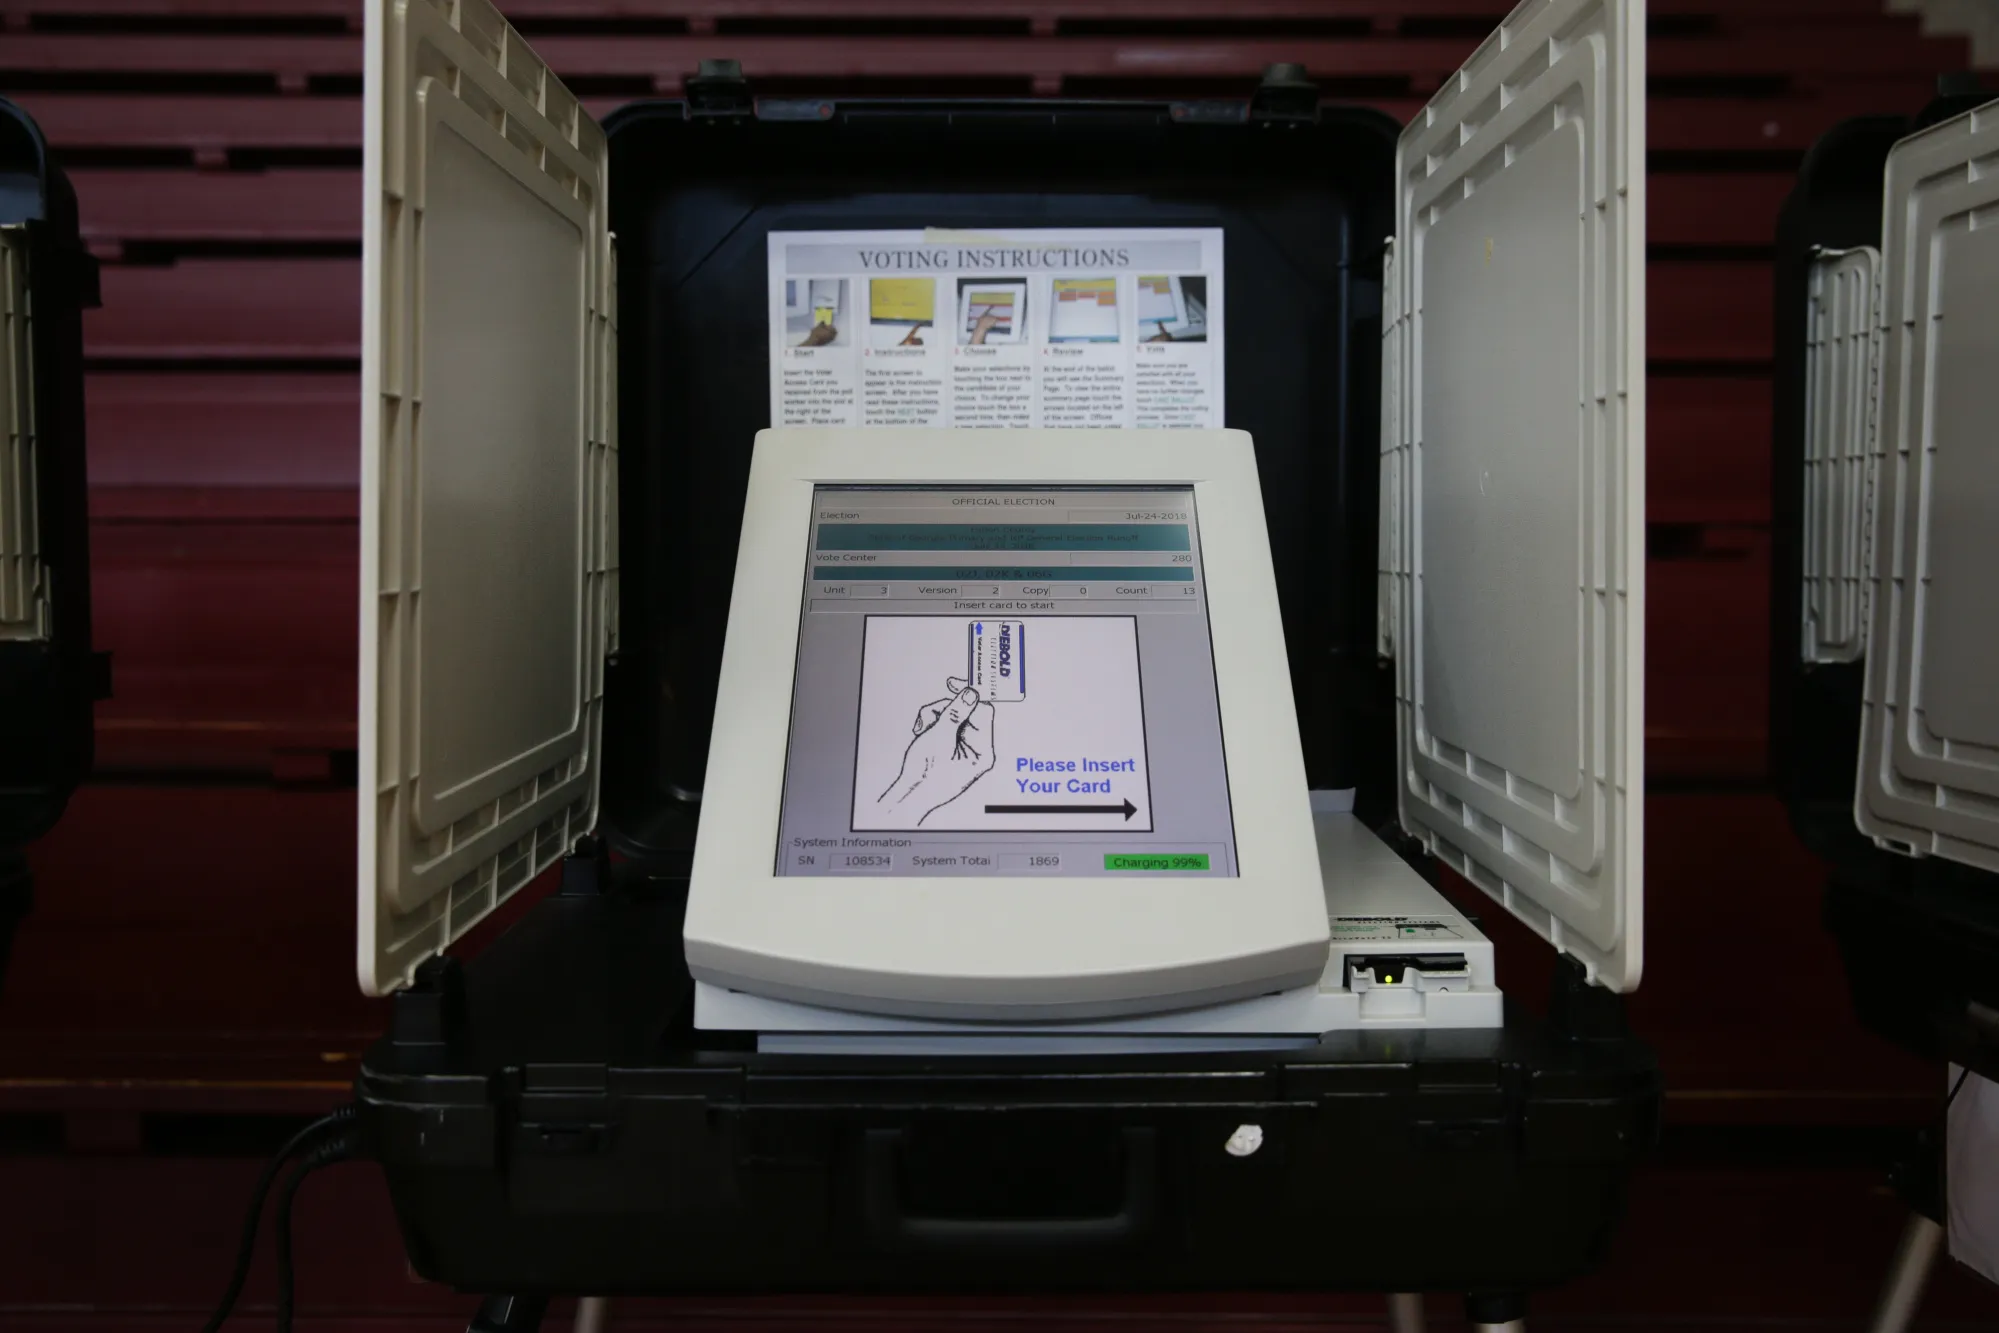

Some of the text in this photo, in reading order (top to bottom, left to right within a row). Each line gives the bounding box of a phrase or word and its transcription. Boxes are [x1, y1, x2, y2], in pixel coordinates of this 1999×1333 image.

[859, 249, 1130, 269] VOTING INSTRUCTIONS
[874, 348, 926, 356] Instructions
[952, 498, 1055, 506] OFFICIAL ELECTION
[1126, 512, 1188, 520] Jul-24-2018
[816, 554, 877, 562] Vote Center
[1172, 554, 1192, 562] 280
[824, 586, 846, 594] Unit
[880, 586, 888, 594] 3
[918, 586, 958, 594] Version
[992, 586, 1000, 594] 2
[1022, 586, 1049, 596] Copy
[1080, 587, 1087, 595] 0
[1116, 586, 1148, 595] Count
[1183, 587, 1196, 595] 13
[954, 601, 986, 609] Insert
[989, 601, 1012, 609] card
[999, 624, 1011, 678] DIEBOLD
[1016, 757, 1136, 772] Please Insert
[1016, 778, 1112, 794] Your Card
[793, 838, 912, 848] System Information
[798, 856, 815, 866] SN
[845, 856, 890, 866] 108534
[912, 856, 957, 866] System
[1029, 856, 1060, 866] 1869
[1114, 858, 1202, 870] Charging 99%
